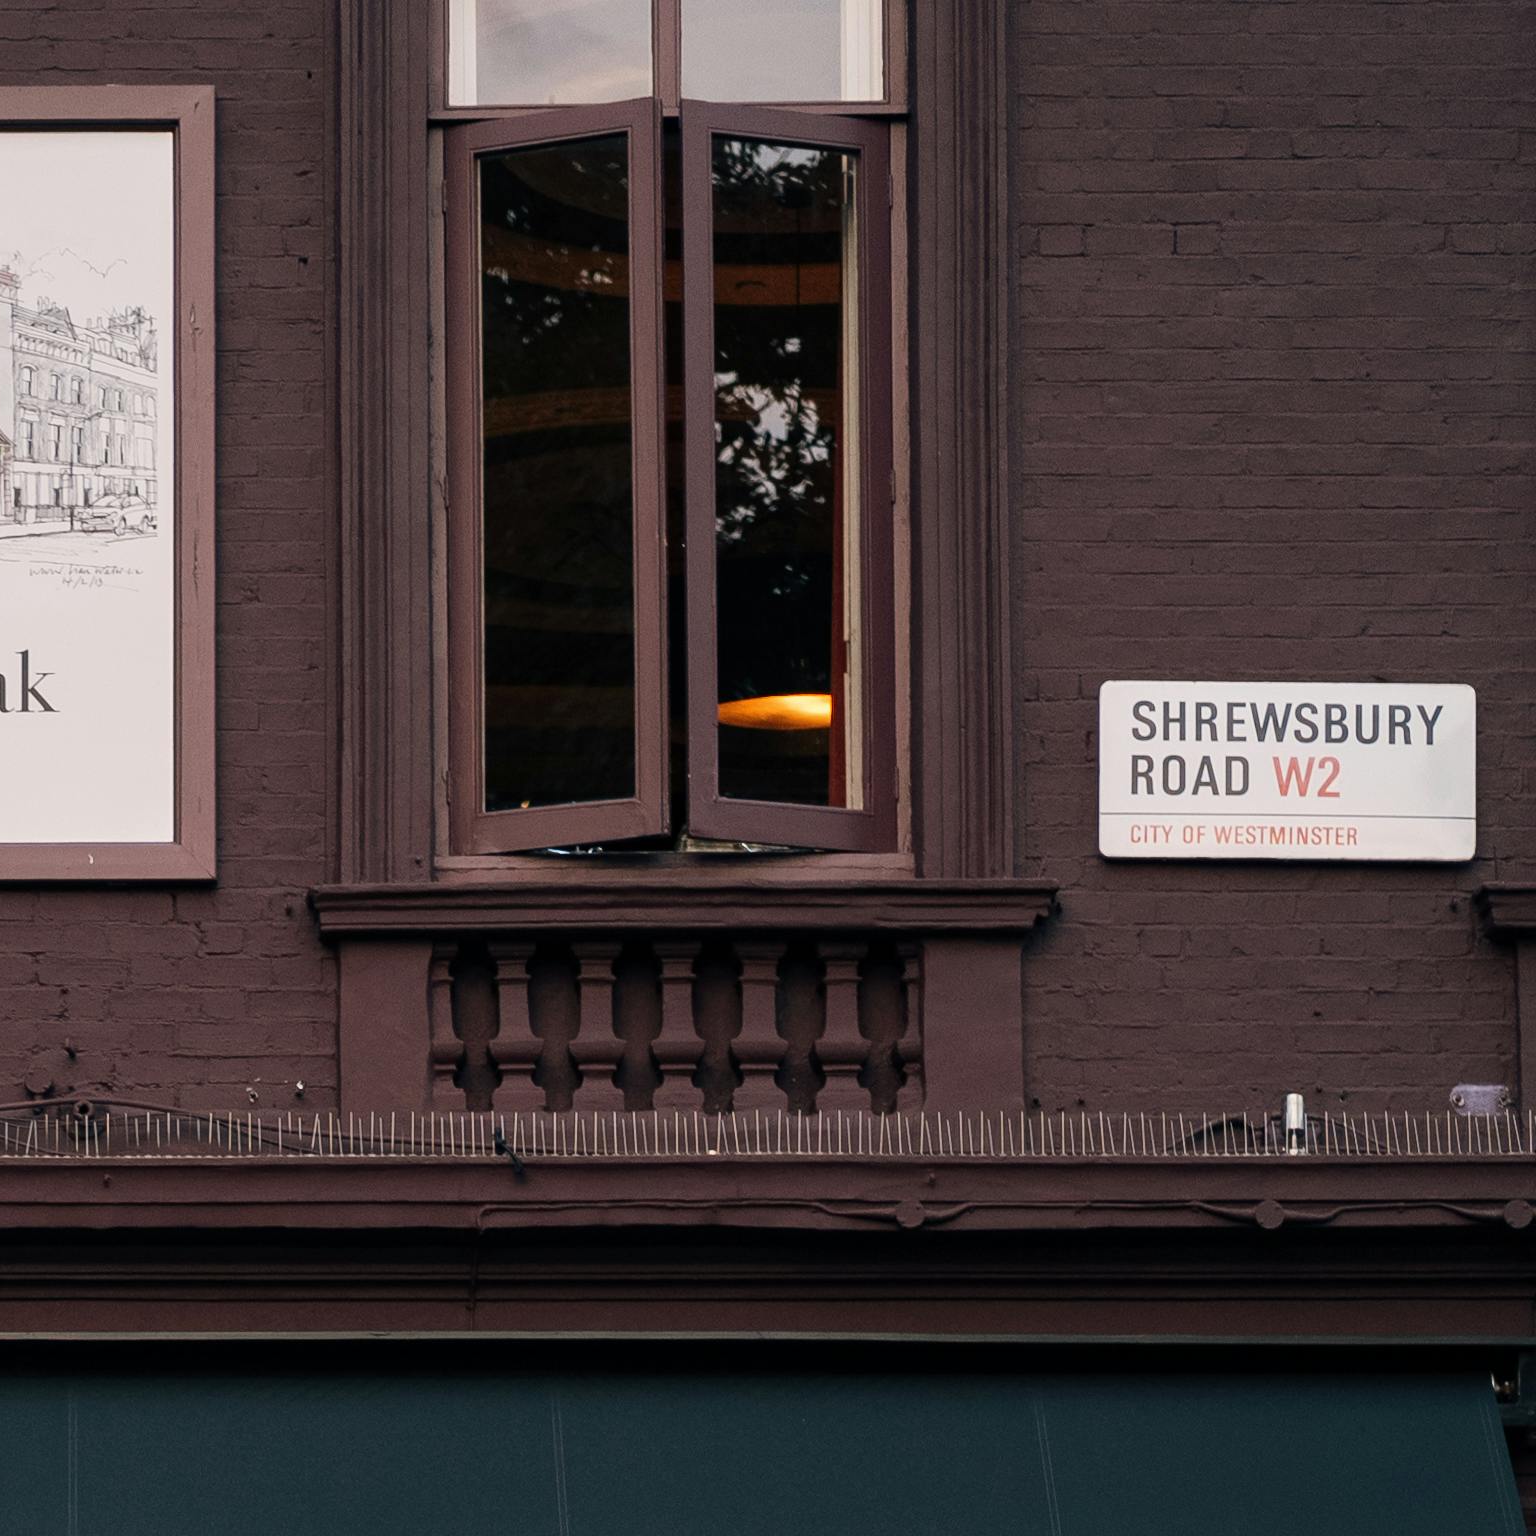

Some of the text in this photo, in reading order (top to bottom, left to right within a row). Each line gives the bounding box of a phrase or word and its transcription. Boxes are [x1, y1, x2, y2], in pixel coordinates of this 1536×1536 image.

[1130, 699, 1445, 747] SHREWSBURY
[1130, 754, 1342, 799] ROAD W2
[1130, 824, 1359, 847] CITY OF WESTMINSTER
